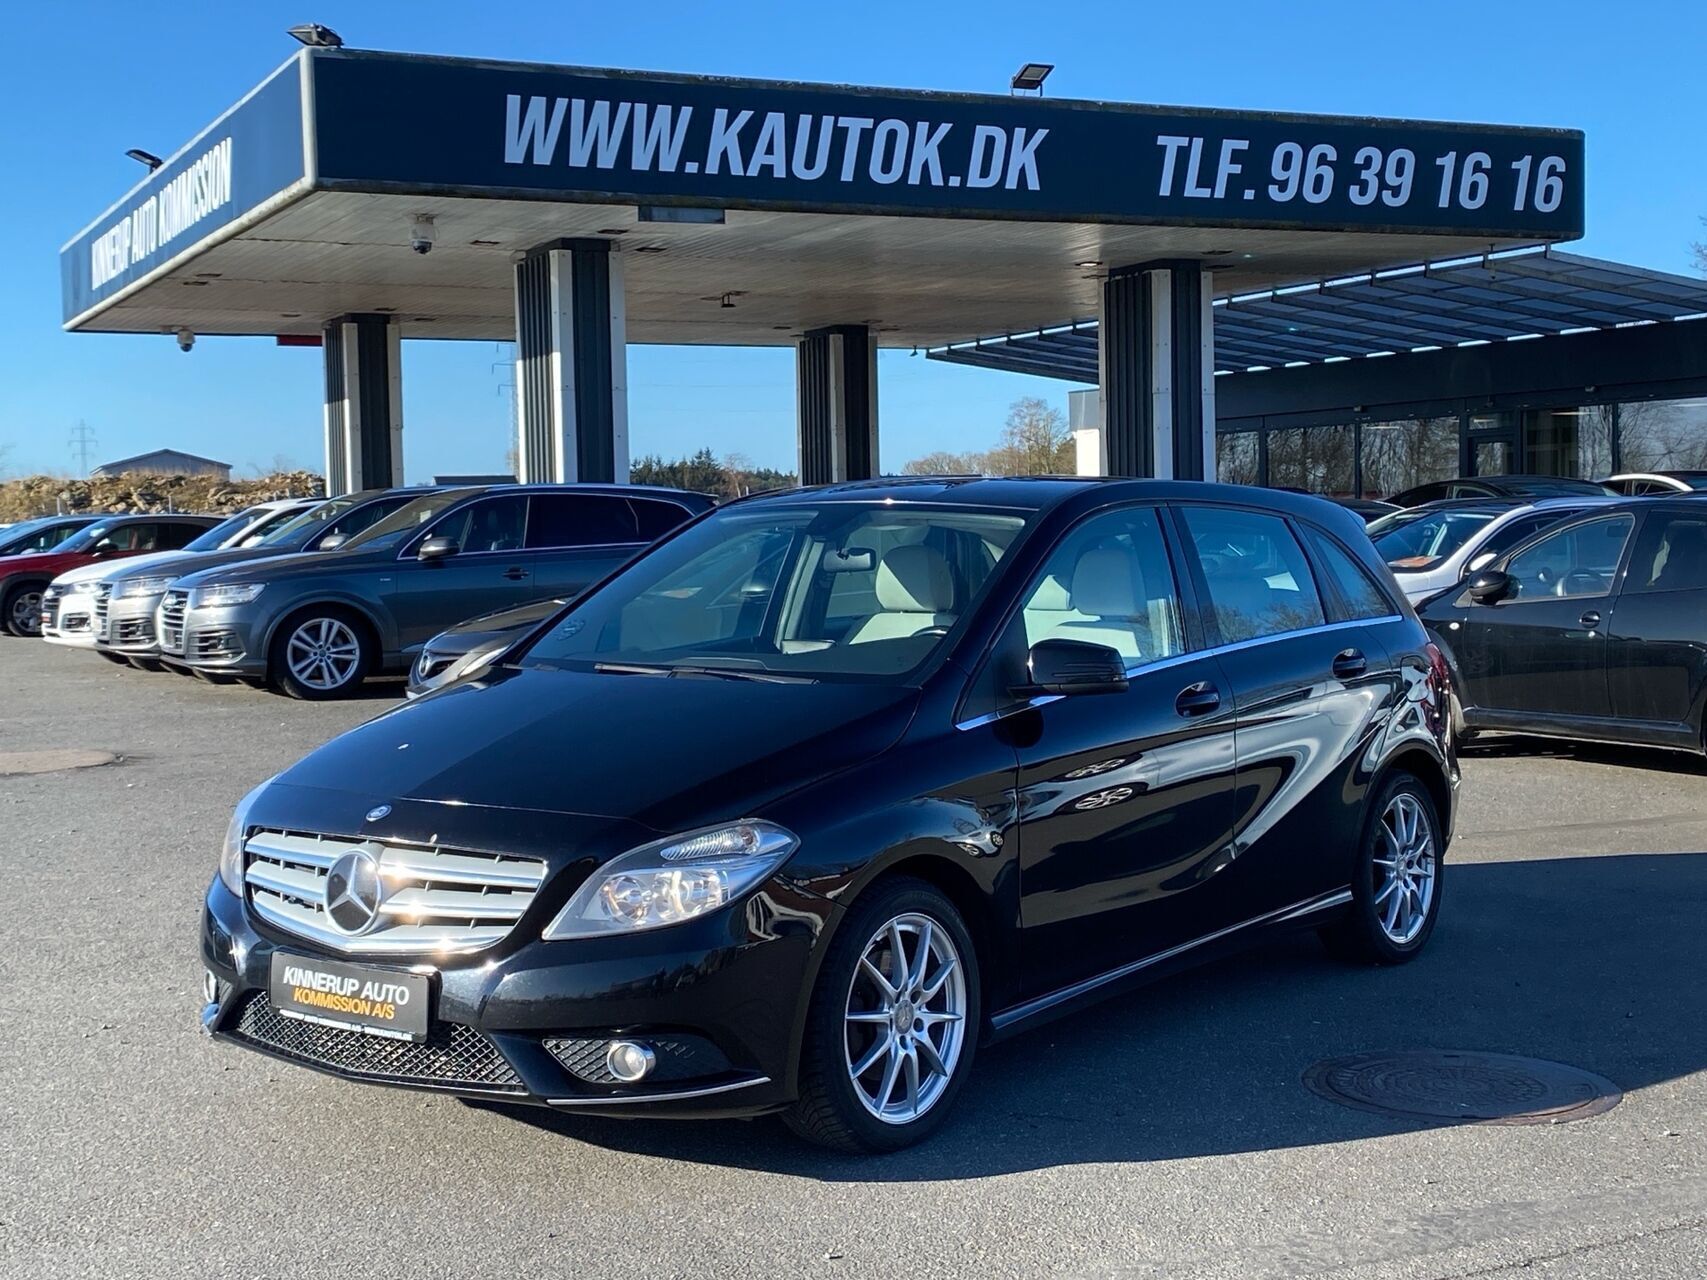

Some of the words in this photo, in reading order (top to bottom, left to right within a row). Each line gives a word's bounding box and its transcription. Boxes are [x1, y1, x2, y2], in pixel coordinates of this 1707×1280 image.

[504, 94, 1049, 190] WWW.KAUTOK.DK
[1156, 135, 1255, 200] TLF.
[1268, 141, 1337, 204] 96
[1349, 146, 1416, 207] 39
[1435, 151, 1492, 210] 16
[1510, 154, 1567, 213] 16
[131, 195, 157, 264] AUTO
[158, 136, 232, 247] KOMMISSION
[283, 966, 359, 996] KINNERUP
[360, 981, 410, 1005] AUTO
[294, 987, 371, 1016] KOMMISSION
[372, 1003, 396, 1020] A/S
